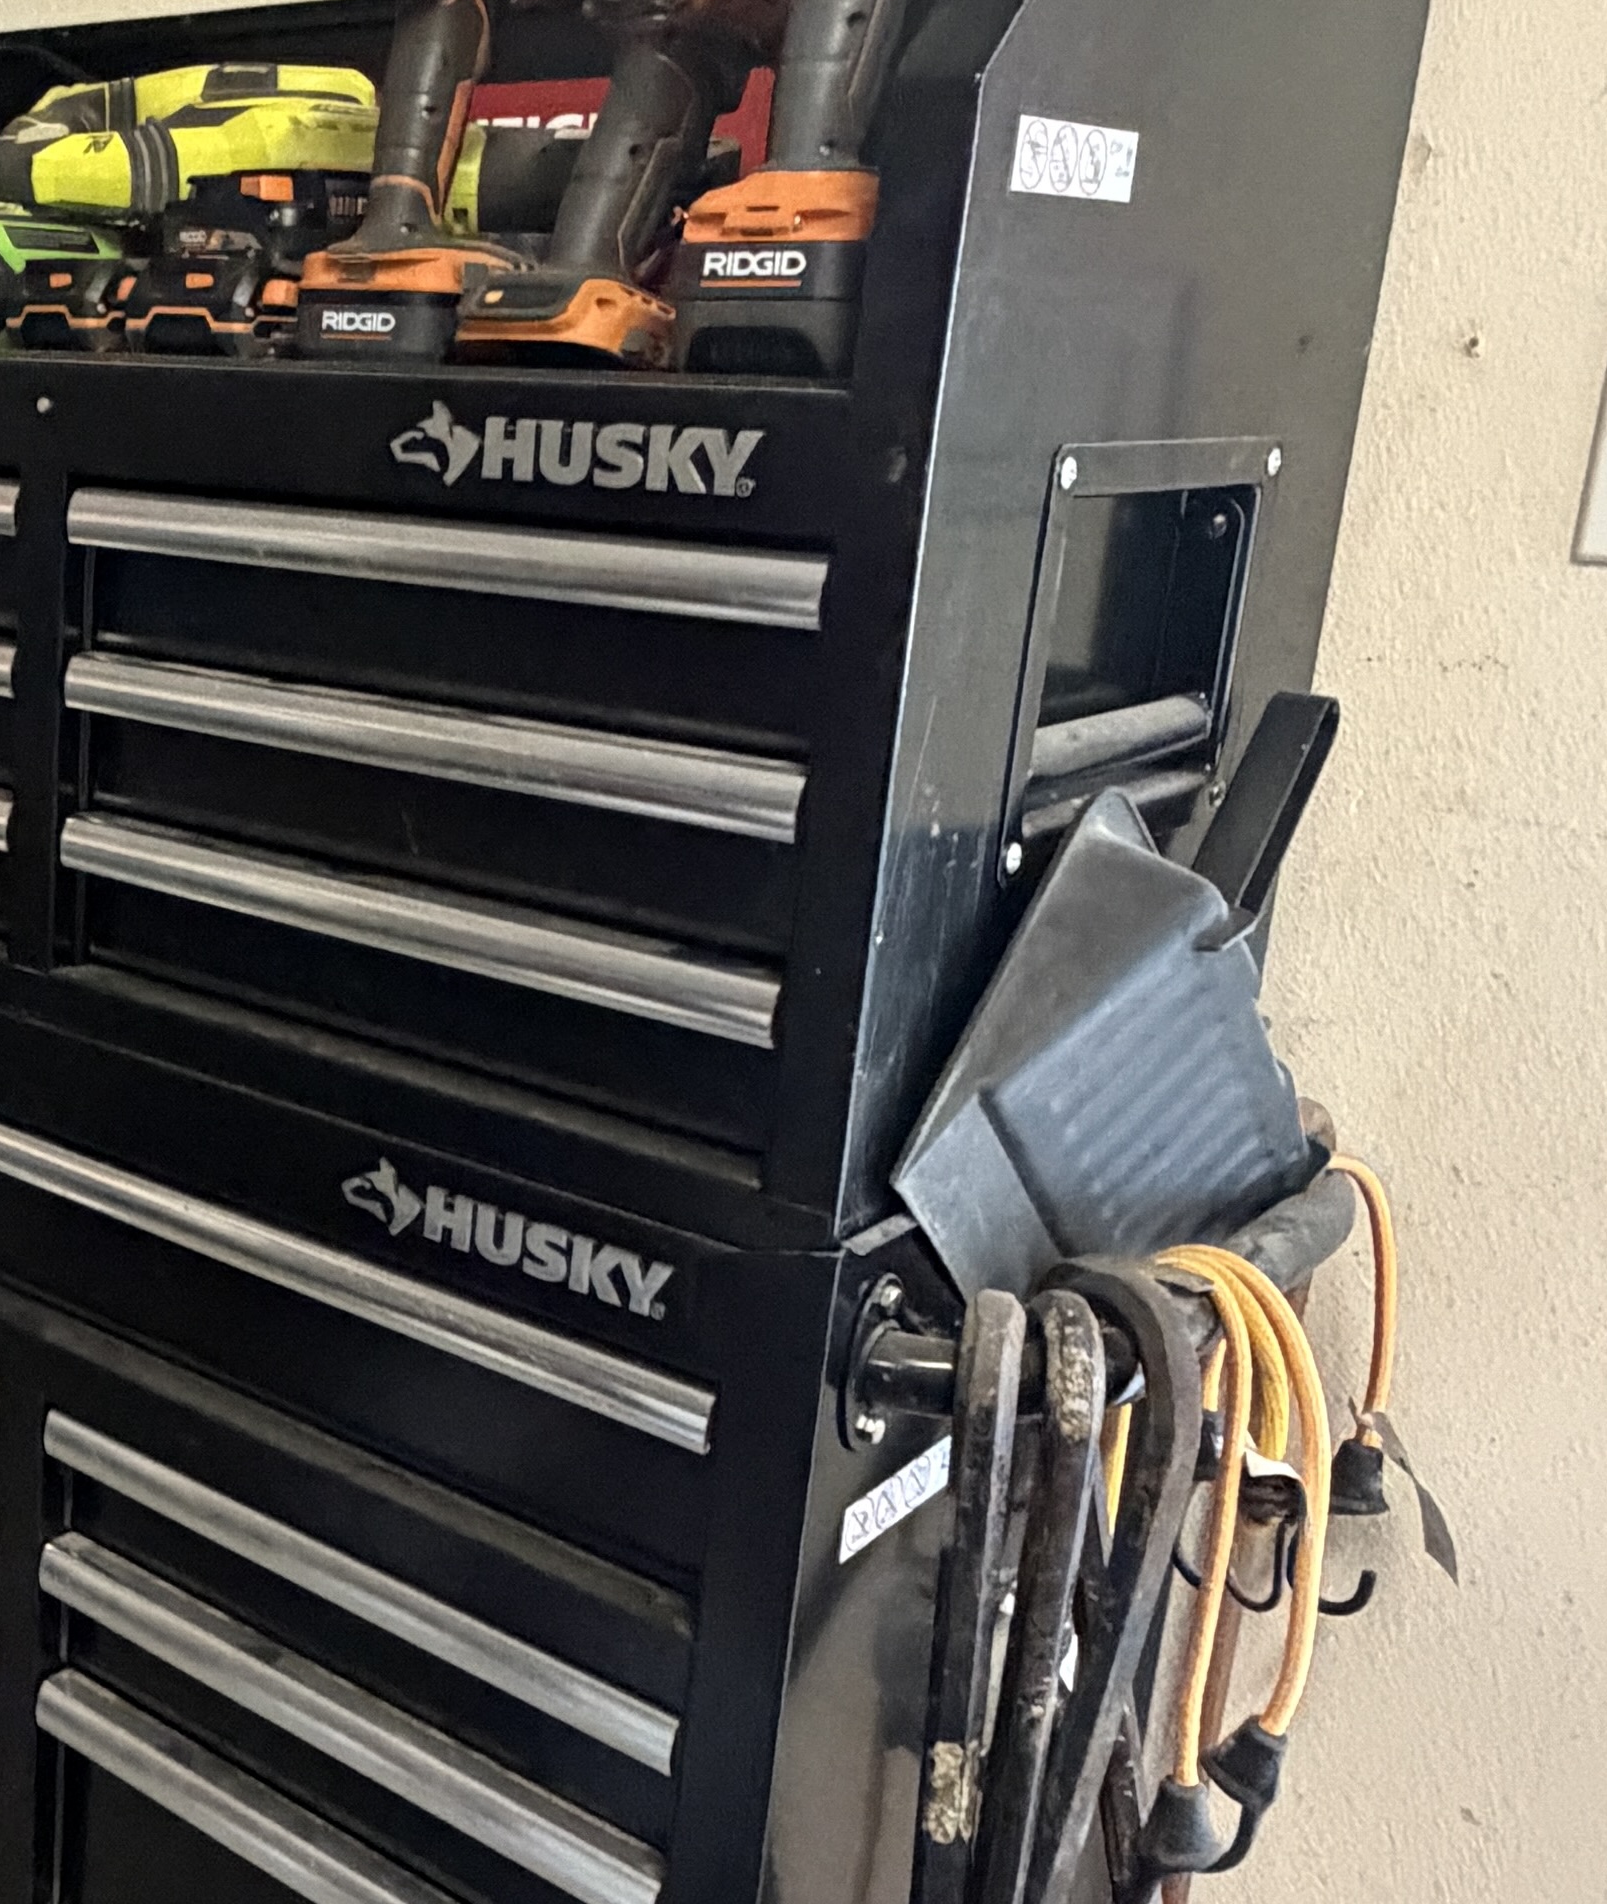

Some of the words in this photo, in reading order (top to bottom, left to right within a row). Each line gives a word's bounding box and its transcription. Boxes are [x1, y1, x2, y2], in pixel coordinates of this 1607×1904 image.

[702, 250, 807, 278] RIDGID
[320, 310, 396, 333] RIDGID
[481, 415, 766, 496] HUSKY
[423, 1184, 674, 1317] HUSKY
